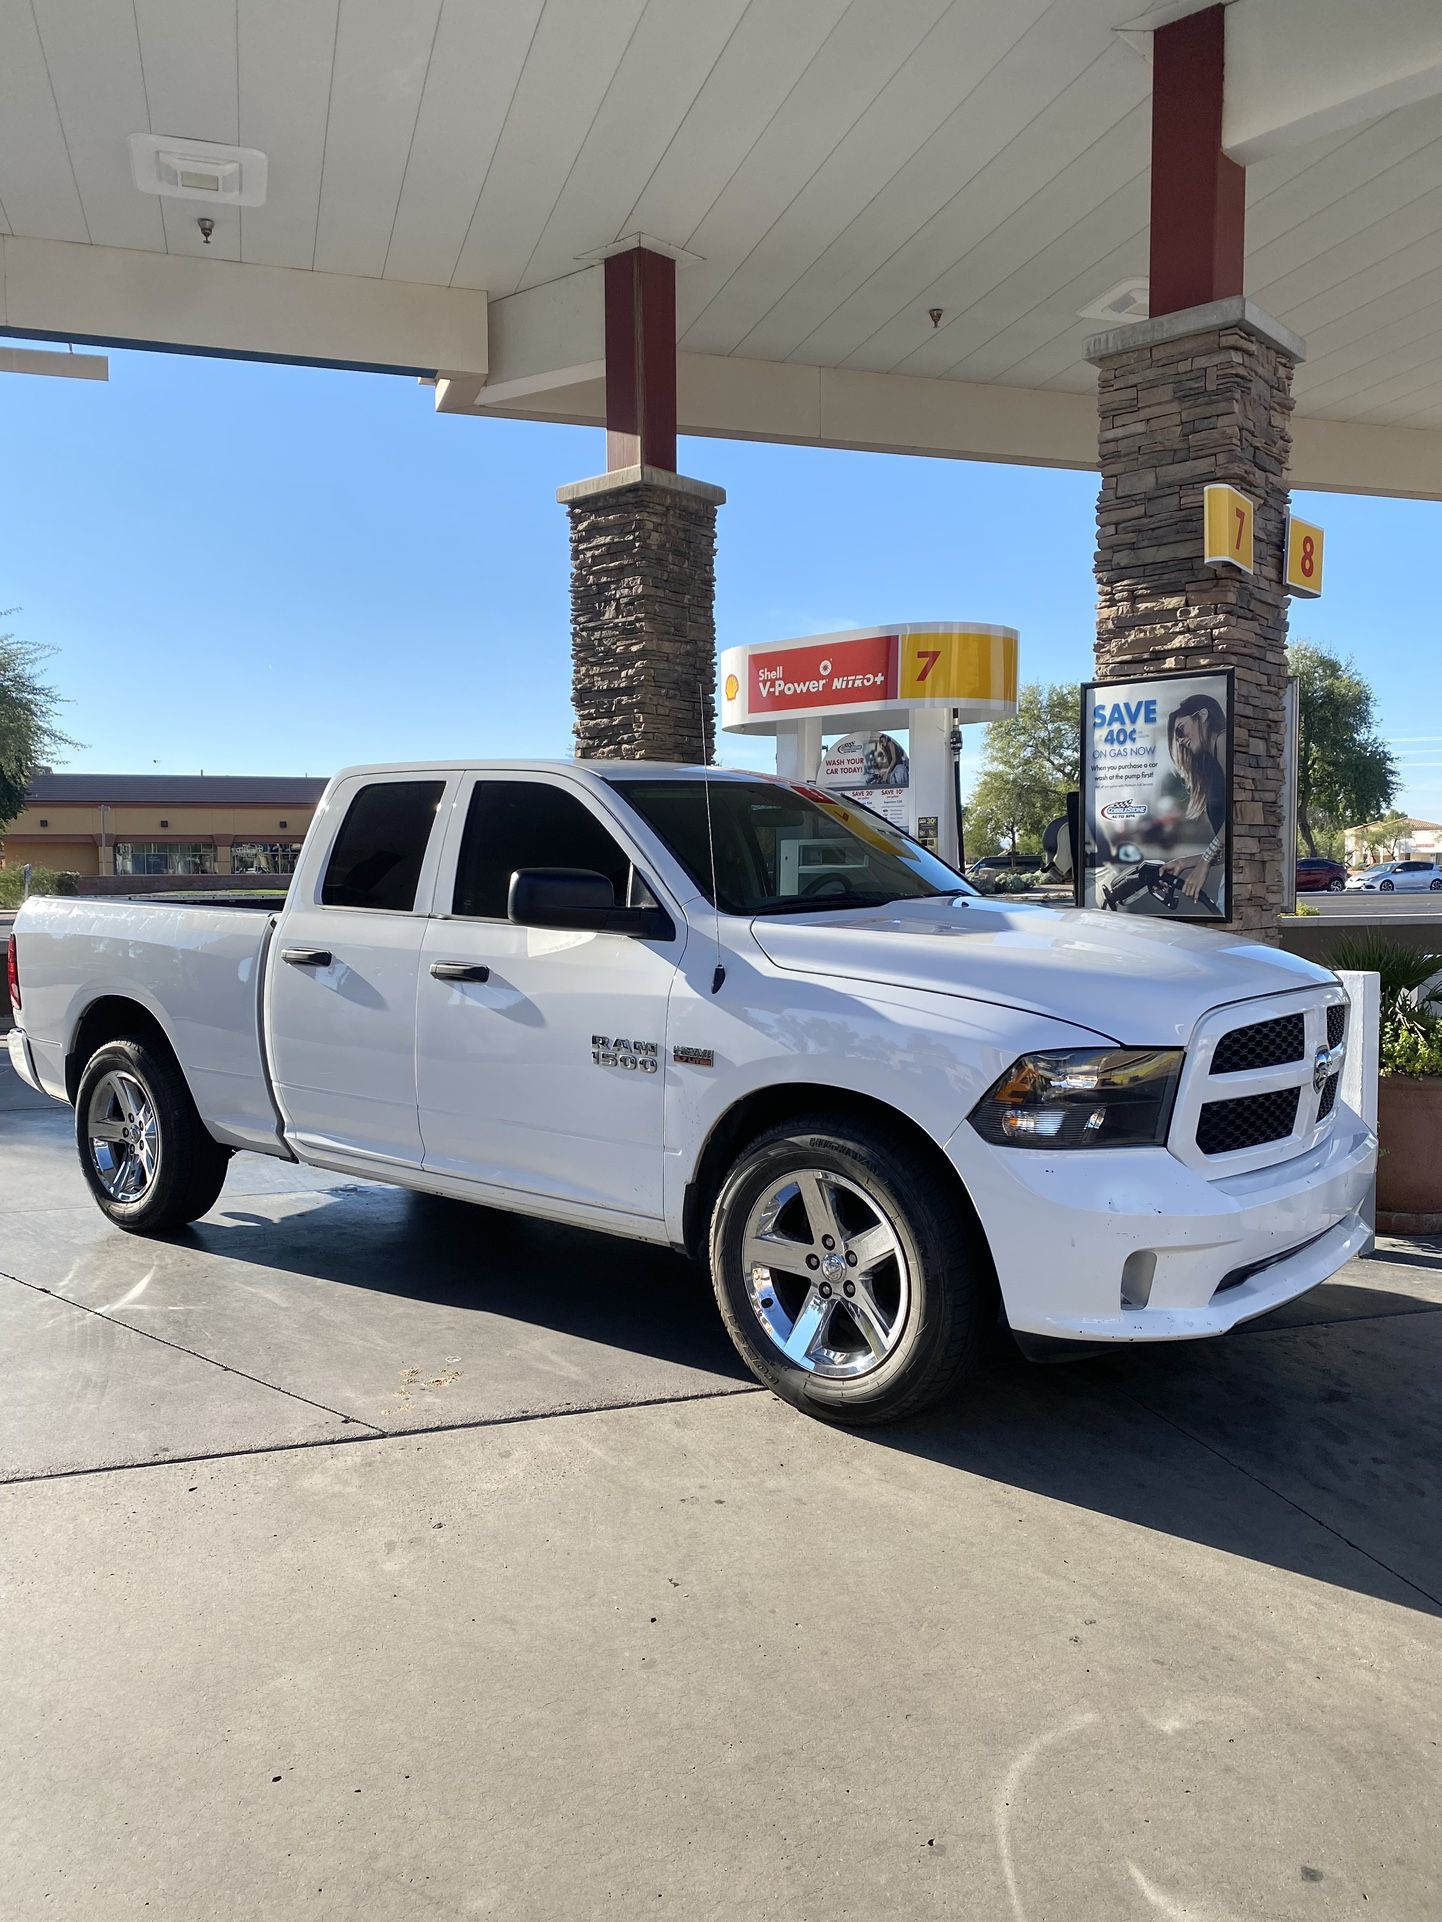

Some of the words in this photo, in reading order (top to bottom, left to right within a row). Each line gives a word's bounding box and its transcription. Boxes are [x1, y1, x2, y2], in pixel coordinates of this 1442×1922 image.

[1235, 507, 1246, 551] 7
[1300, 535, 1315, 578] 8
[758, 665, 783, 681] Shell
[915, 650, 942, 682] 7
[758, 679, 826, 698] V-Power
[1093, 699, 1157, 728] SAVE
[1103, 727, 1137, 746] 40¢
[825, 759, 845, 767] WASH
[846, 757, 865, 766] YOUR
[1092, 749, 1107, 760] ON
[1109, 747, 1128, 758] GAS
[1130, 745, 1156, 756] NOW
[825, 768, 839, 776] CAR
[840, 766, 863, 775] TODAY!
[1091, 764, 1107, 772] When
[1107, 764, 1118, 772] you
[1118, 762, 1143, 772] purchase
[1115, 772, 1124, 780] the
[1124, 773, 1141, 781] pump
[591, 1034, 658, 1057] RAM
[591, 1050, 658, 1074] 1500
